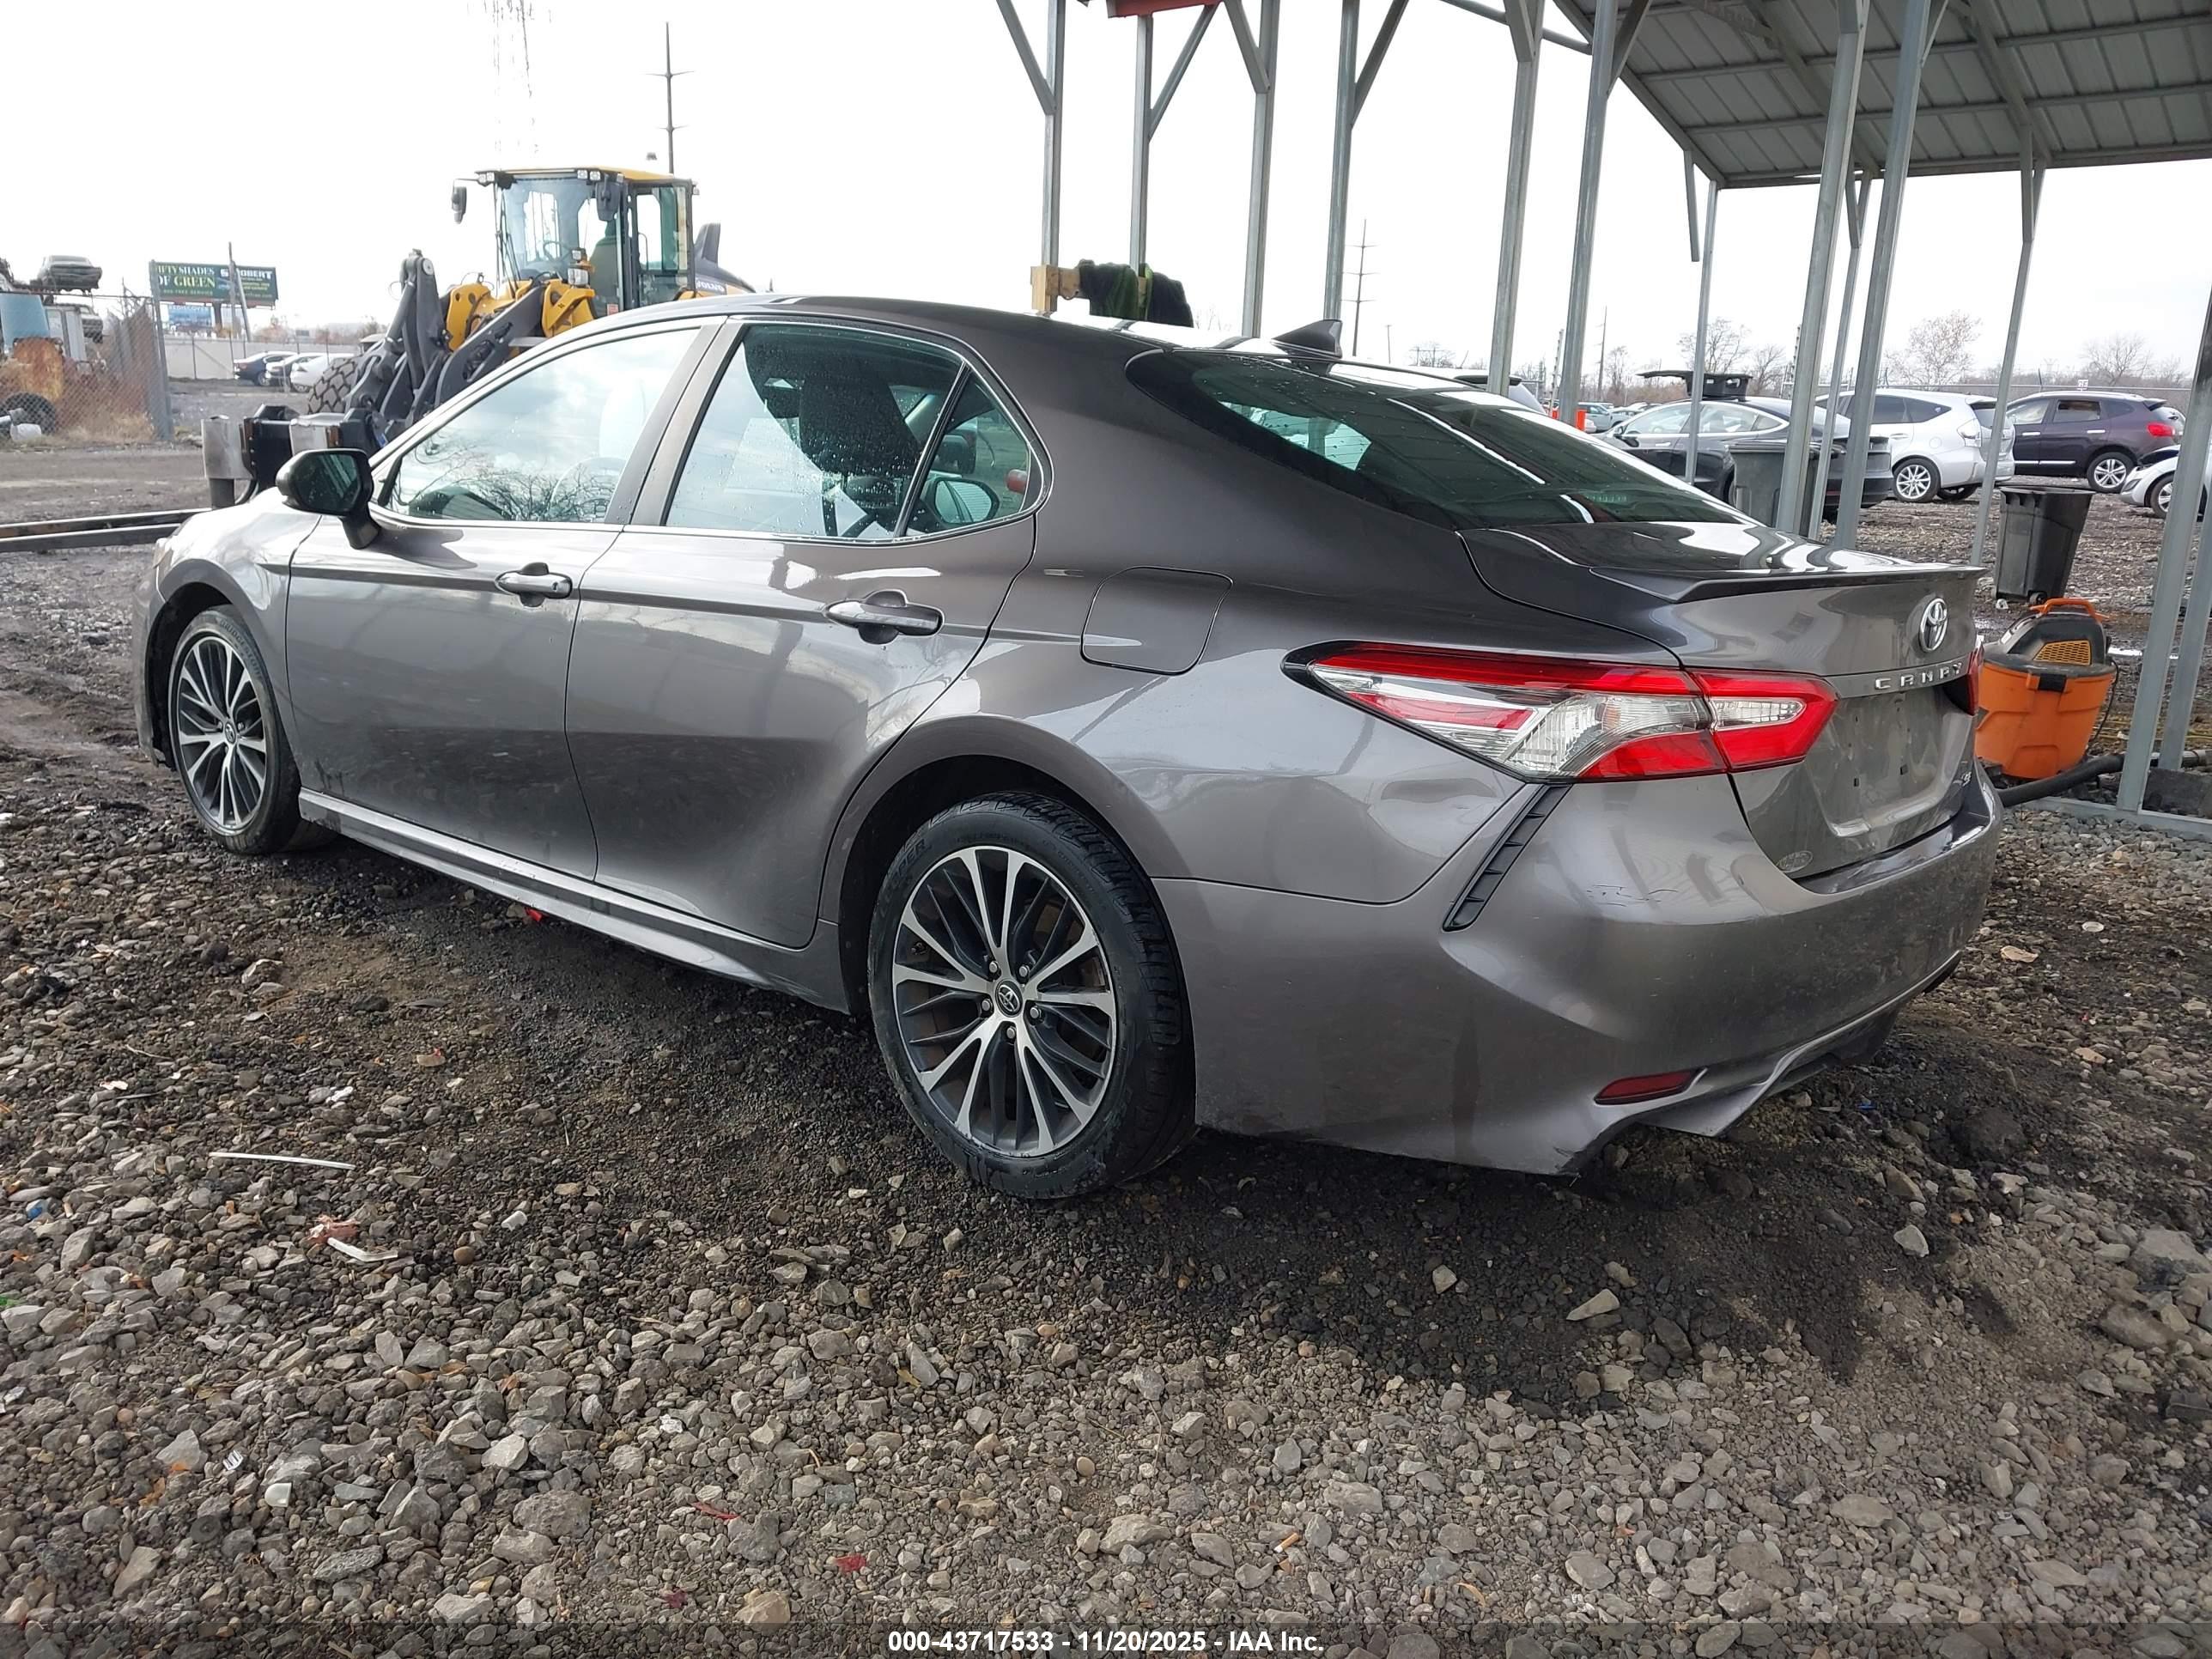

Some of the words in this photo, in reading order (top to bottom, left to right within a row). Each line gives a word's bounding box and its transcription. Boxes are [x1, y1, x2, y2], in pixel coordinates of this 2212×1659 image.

[179, 266, 215, 275] SHADES
[173, 276, 216, 288] GREEN
[1875, 662, 1963, 690] CAMRY
